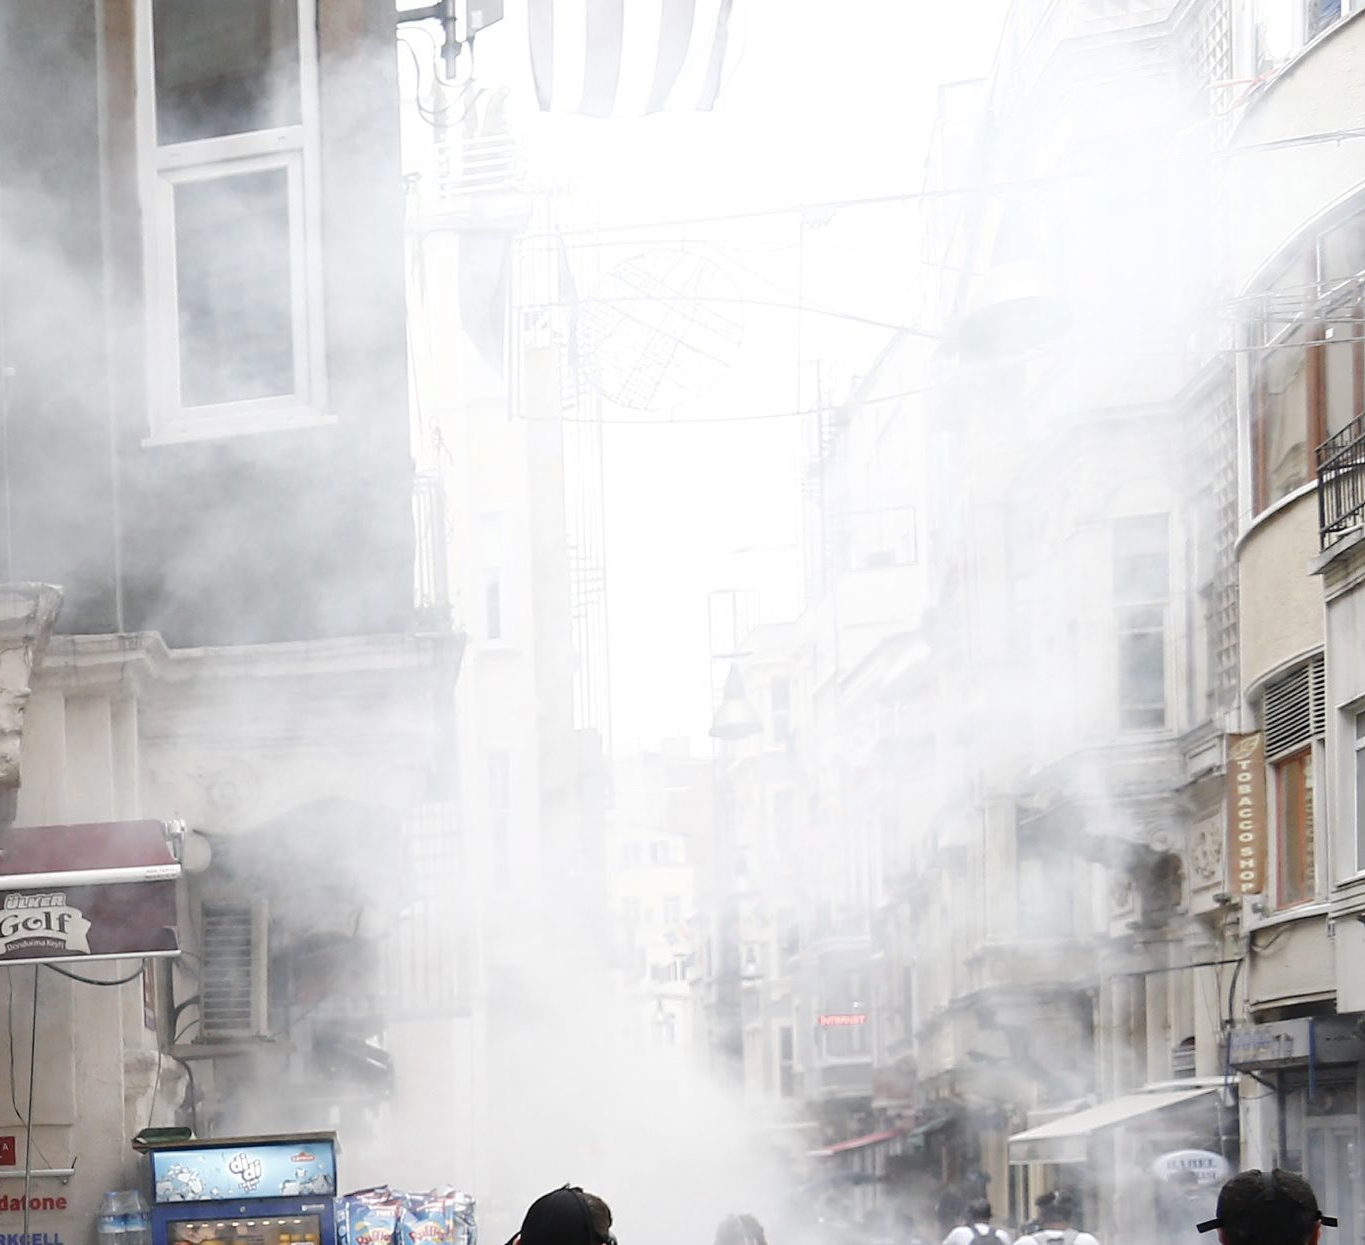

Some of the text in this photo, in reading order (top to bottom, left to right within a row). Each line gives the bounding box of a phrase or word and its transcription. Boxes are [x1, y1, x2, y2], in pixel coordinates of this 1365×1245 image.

[1237, 760, 1255, 892] TOBACCO SHOP
[6, 893, 66, 909] ÜLKER
